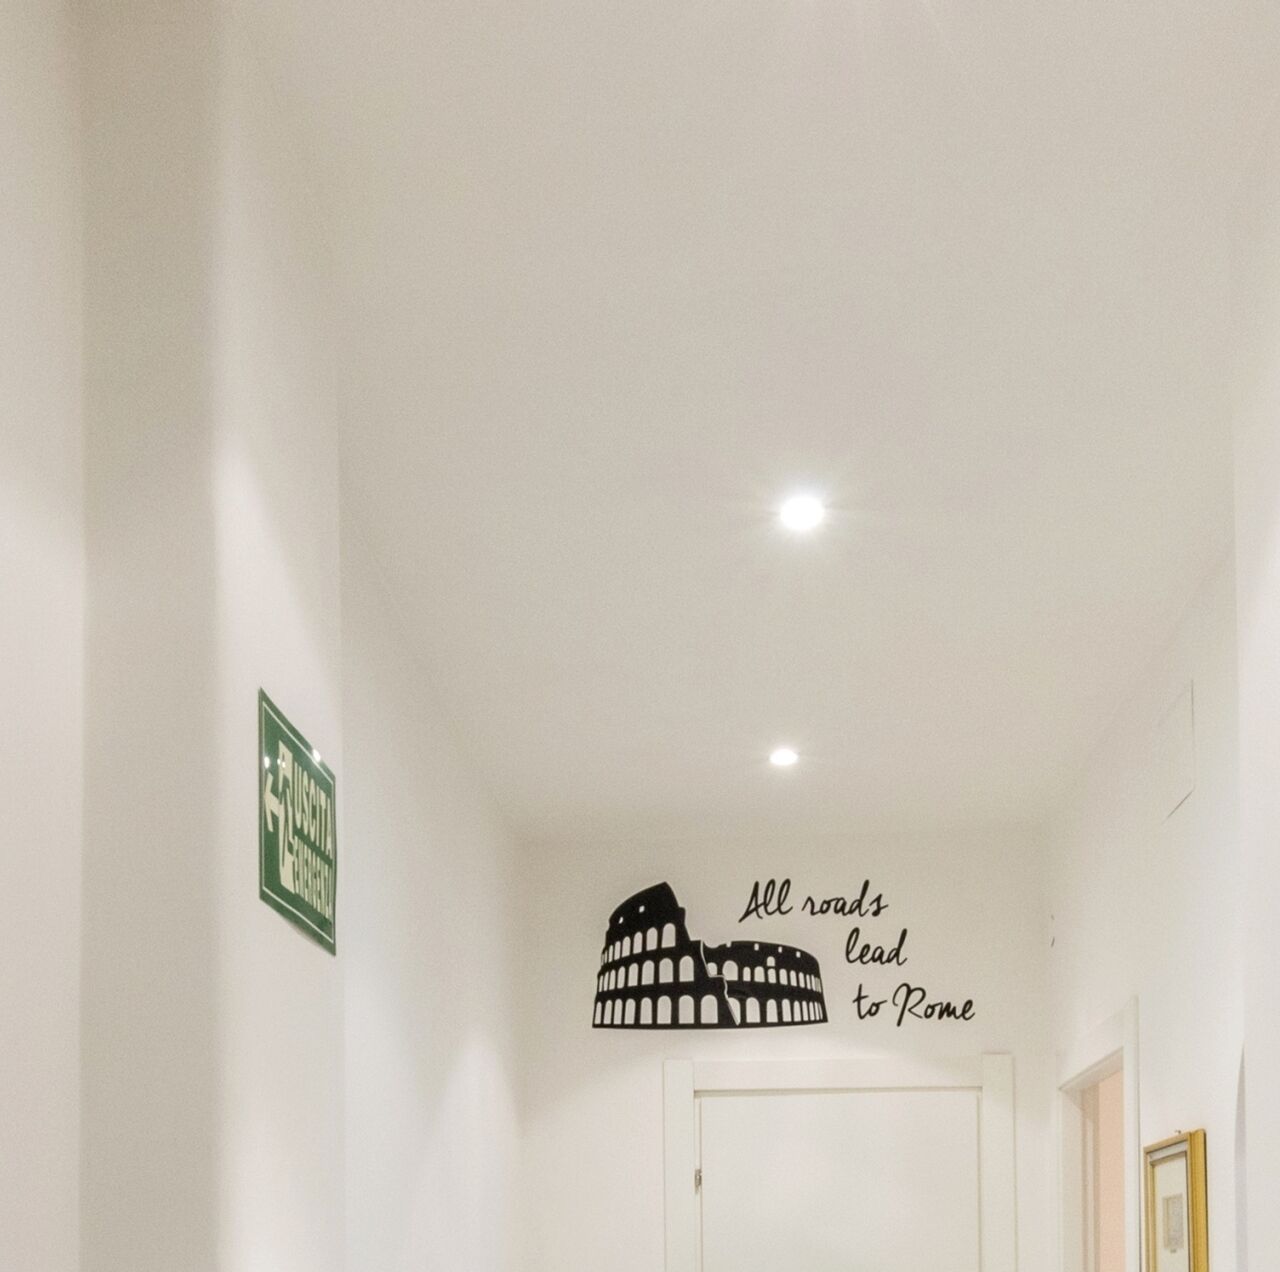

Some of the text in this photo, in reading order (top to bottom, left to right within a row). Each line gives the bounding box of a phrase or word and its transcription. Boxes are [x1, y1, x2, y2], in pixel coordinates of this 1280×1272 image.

[294, 761, 333, 860] USCITA
[738, 878, 889, 923] All roads
[844, 927, 908, 967] lead
[852, 983, 976, 1027] to Rome
